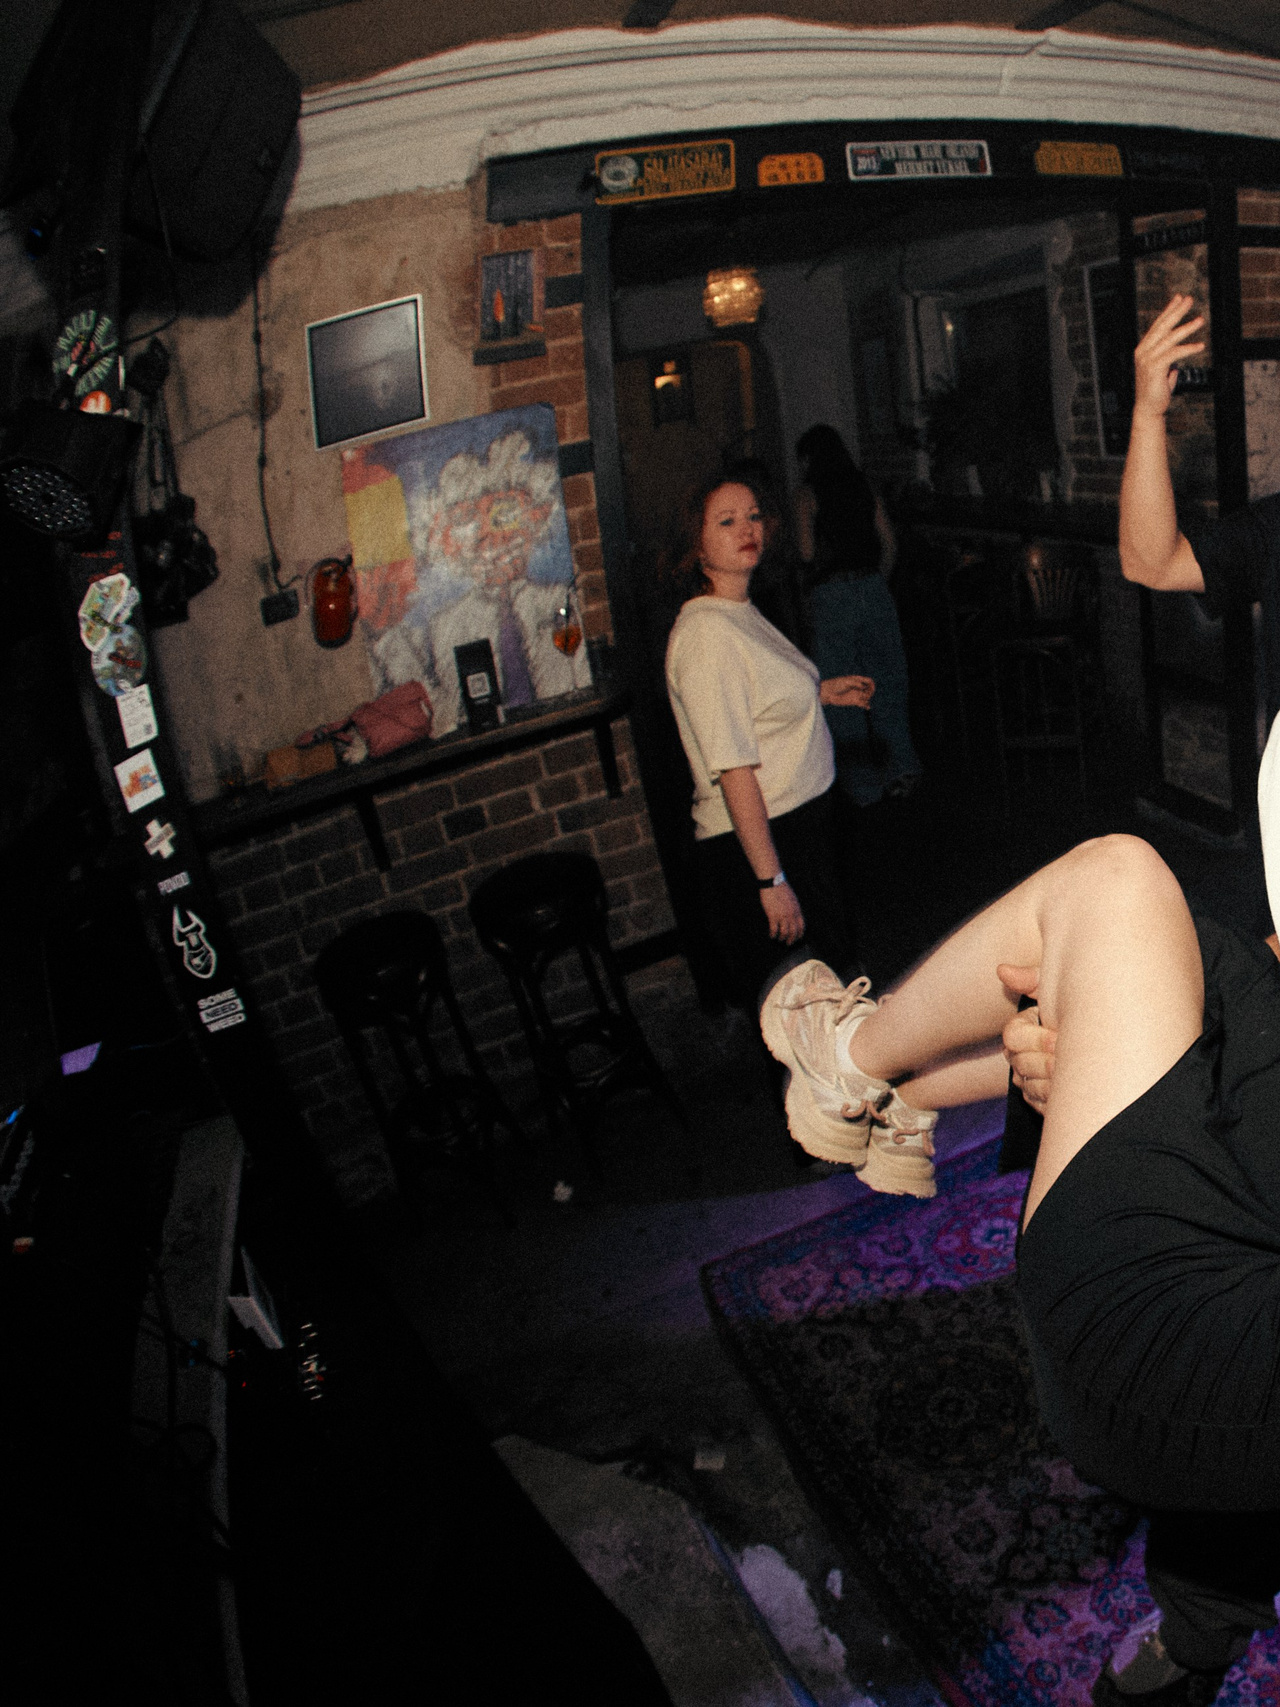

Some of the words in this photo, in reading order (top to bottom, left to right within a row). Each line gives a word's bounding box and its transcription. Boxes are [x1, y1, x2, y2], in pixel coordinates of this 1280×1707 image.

[197, 988, 236, 1009] SOME
[203, 1001, 239, 1020] NEED
[206, 1013, 246, 1032] WEED
